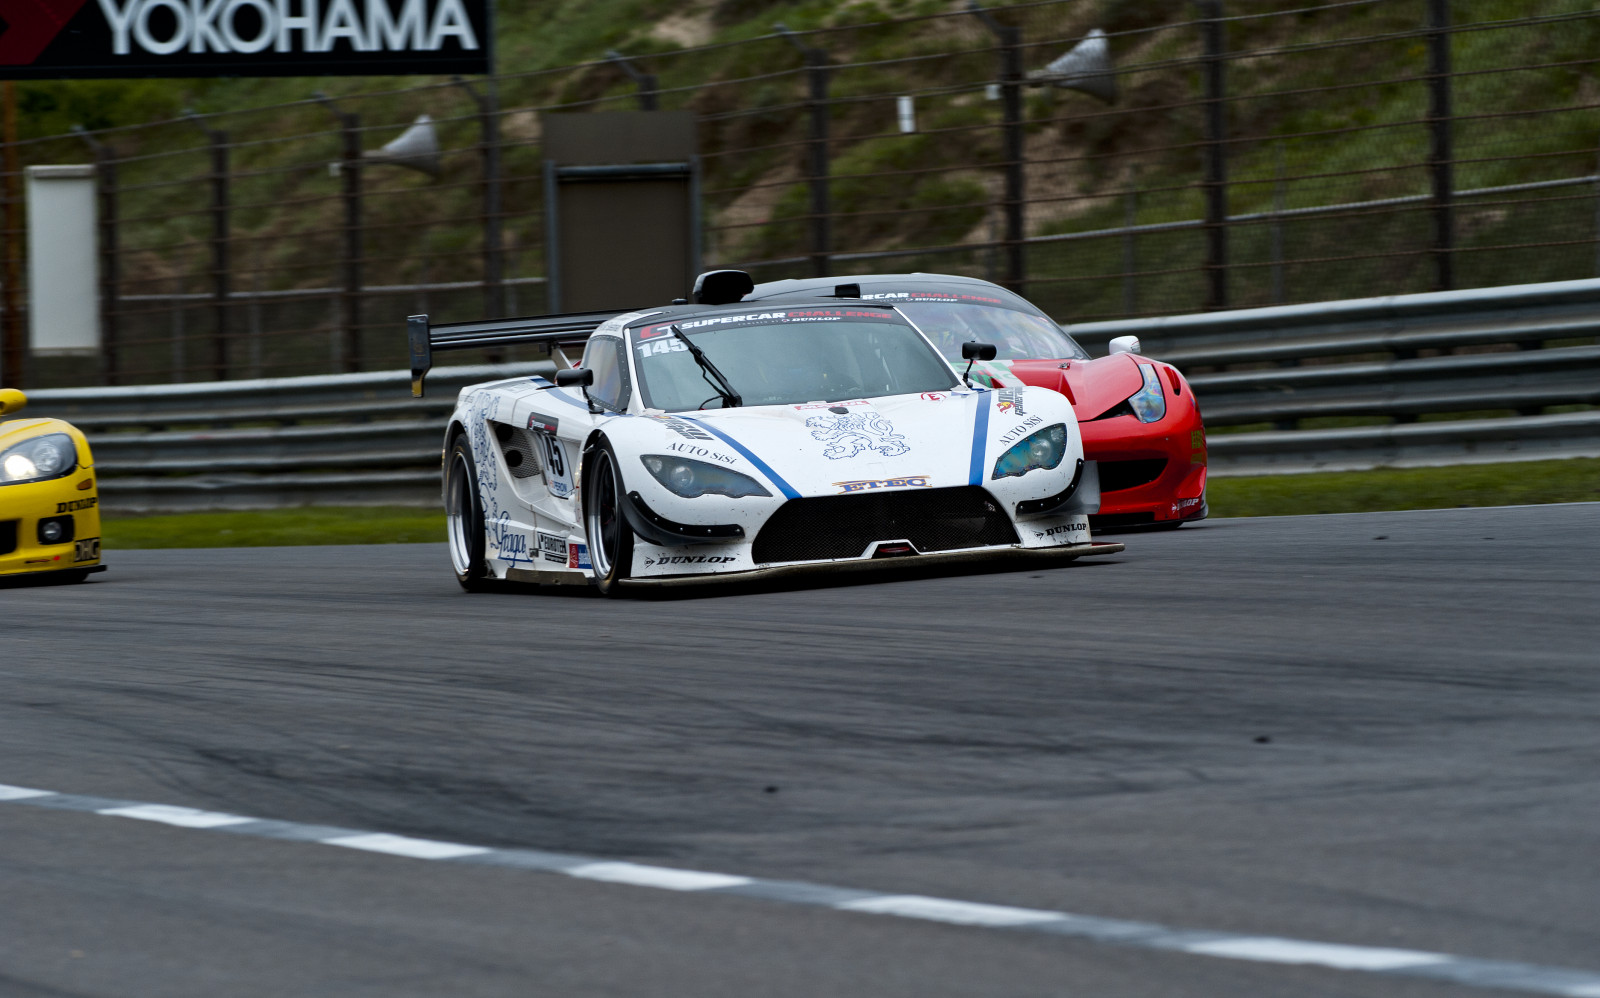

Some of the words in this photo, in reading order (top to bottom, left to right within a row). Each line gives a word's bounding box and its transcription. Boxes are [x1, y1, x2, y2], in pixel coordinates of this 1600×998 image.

[102, 0, 480, 55] YOKOHAMA
[911, 292, 1002, 304] CHALLENGE
[681, 312, 785, 330] SUPERCAR
[787, 311, 893, 319] CHALLENGE
[637, 339, 689, 358] 145
[1000, 425, 1027, 447] AUTO
[666, 442, 709, 457] AUTO
[838, 478, 930, 494] ETEC
[56, 496, 98, 514] DUNLOP
[1045, 523, 1087, 537] DUNLOP
[656, 555, 736, 565] DUNLOP
